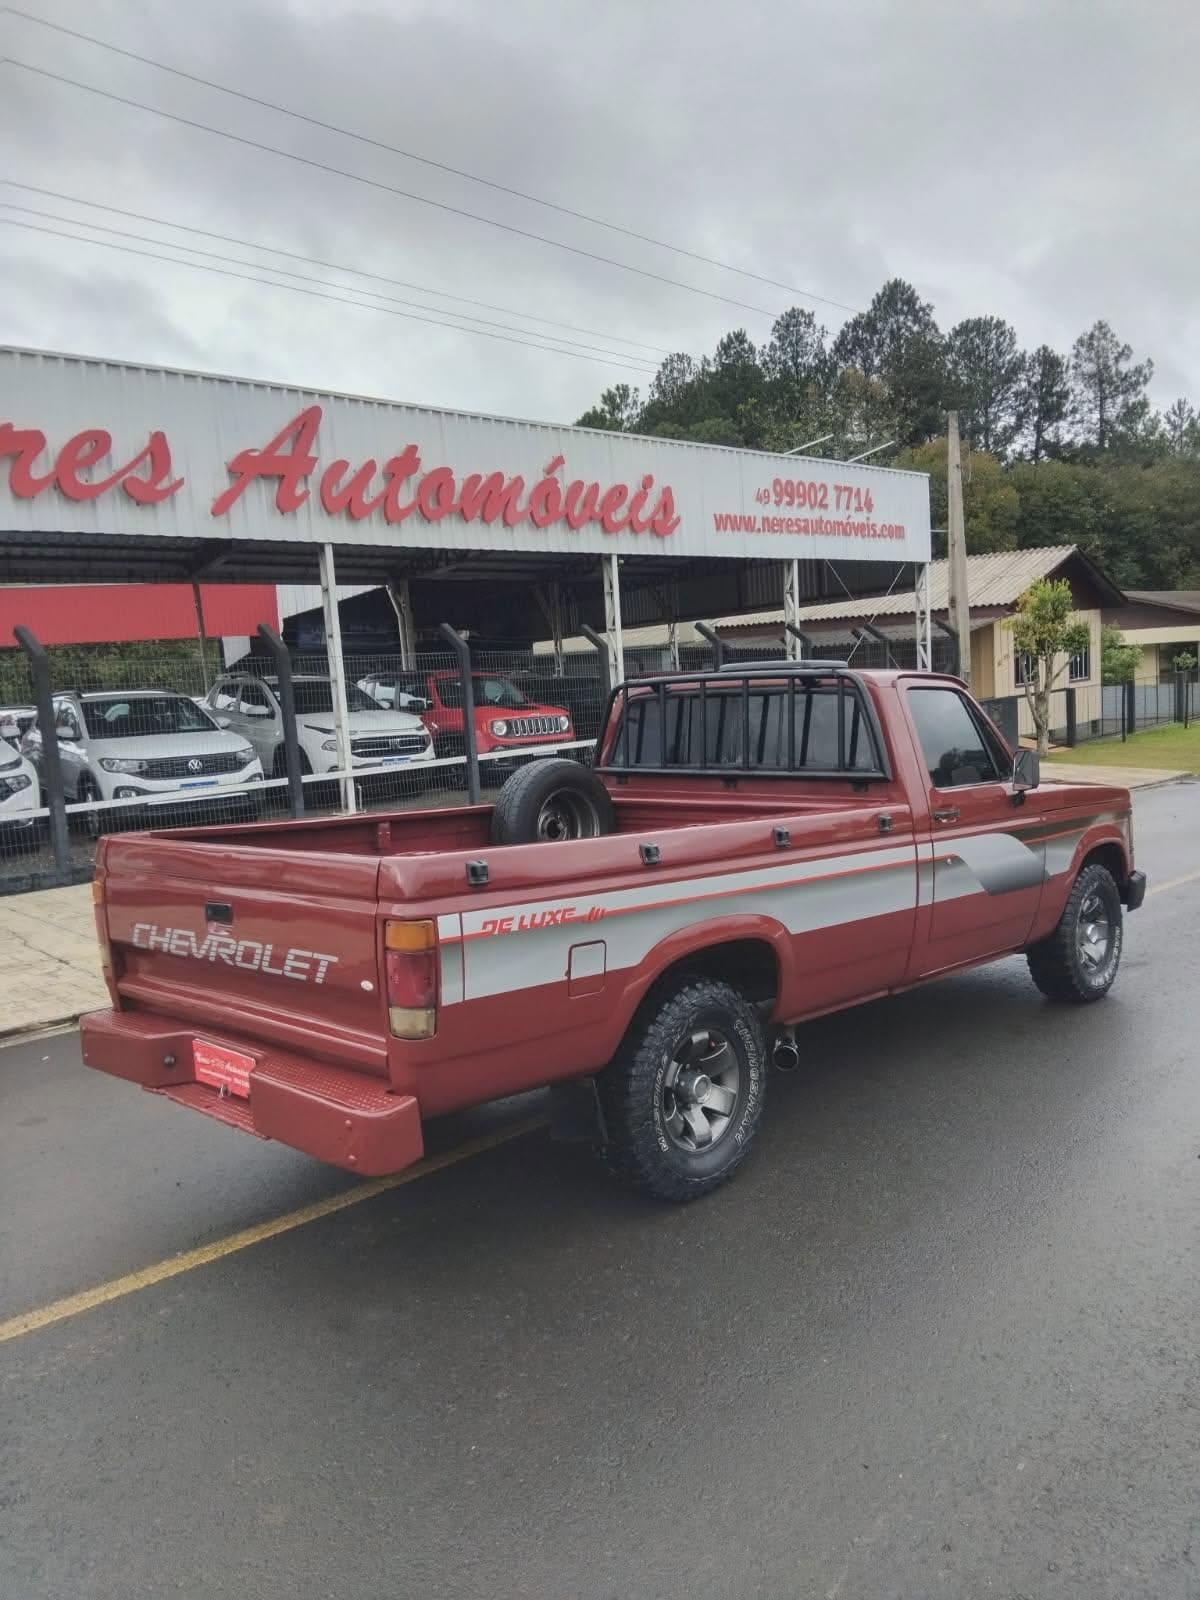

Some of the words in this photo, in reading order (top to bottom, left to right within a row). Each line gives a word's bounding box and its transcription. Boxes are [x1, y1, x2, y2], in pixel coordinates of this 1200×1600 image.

[210, 405, 681, 538] Automóveis
[755, 487, 770, 505] 49
[773, 478, 828, 511] 99902
[834, 484, 874, 513] 7714
[714, 513, 905, 540] www.neresautomóveis.com
[481, 917, 515, 935] DE
[517, 906, 577, 931] LUXE
[131, 922, 339, 984] CHEVROLET
